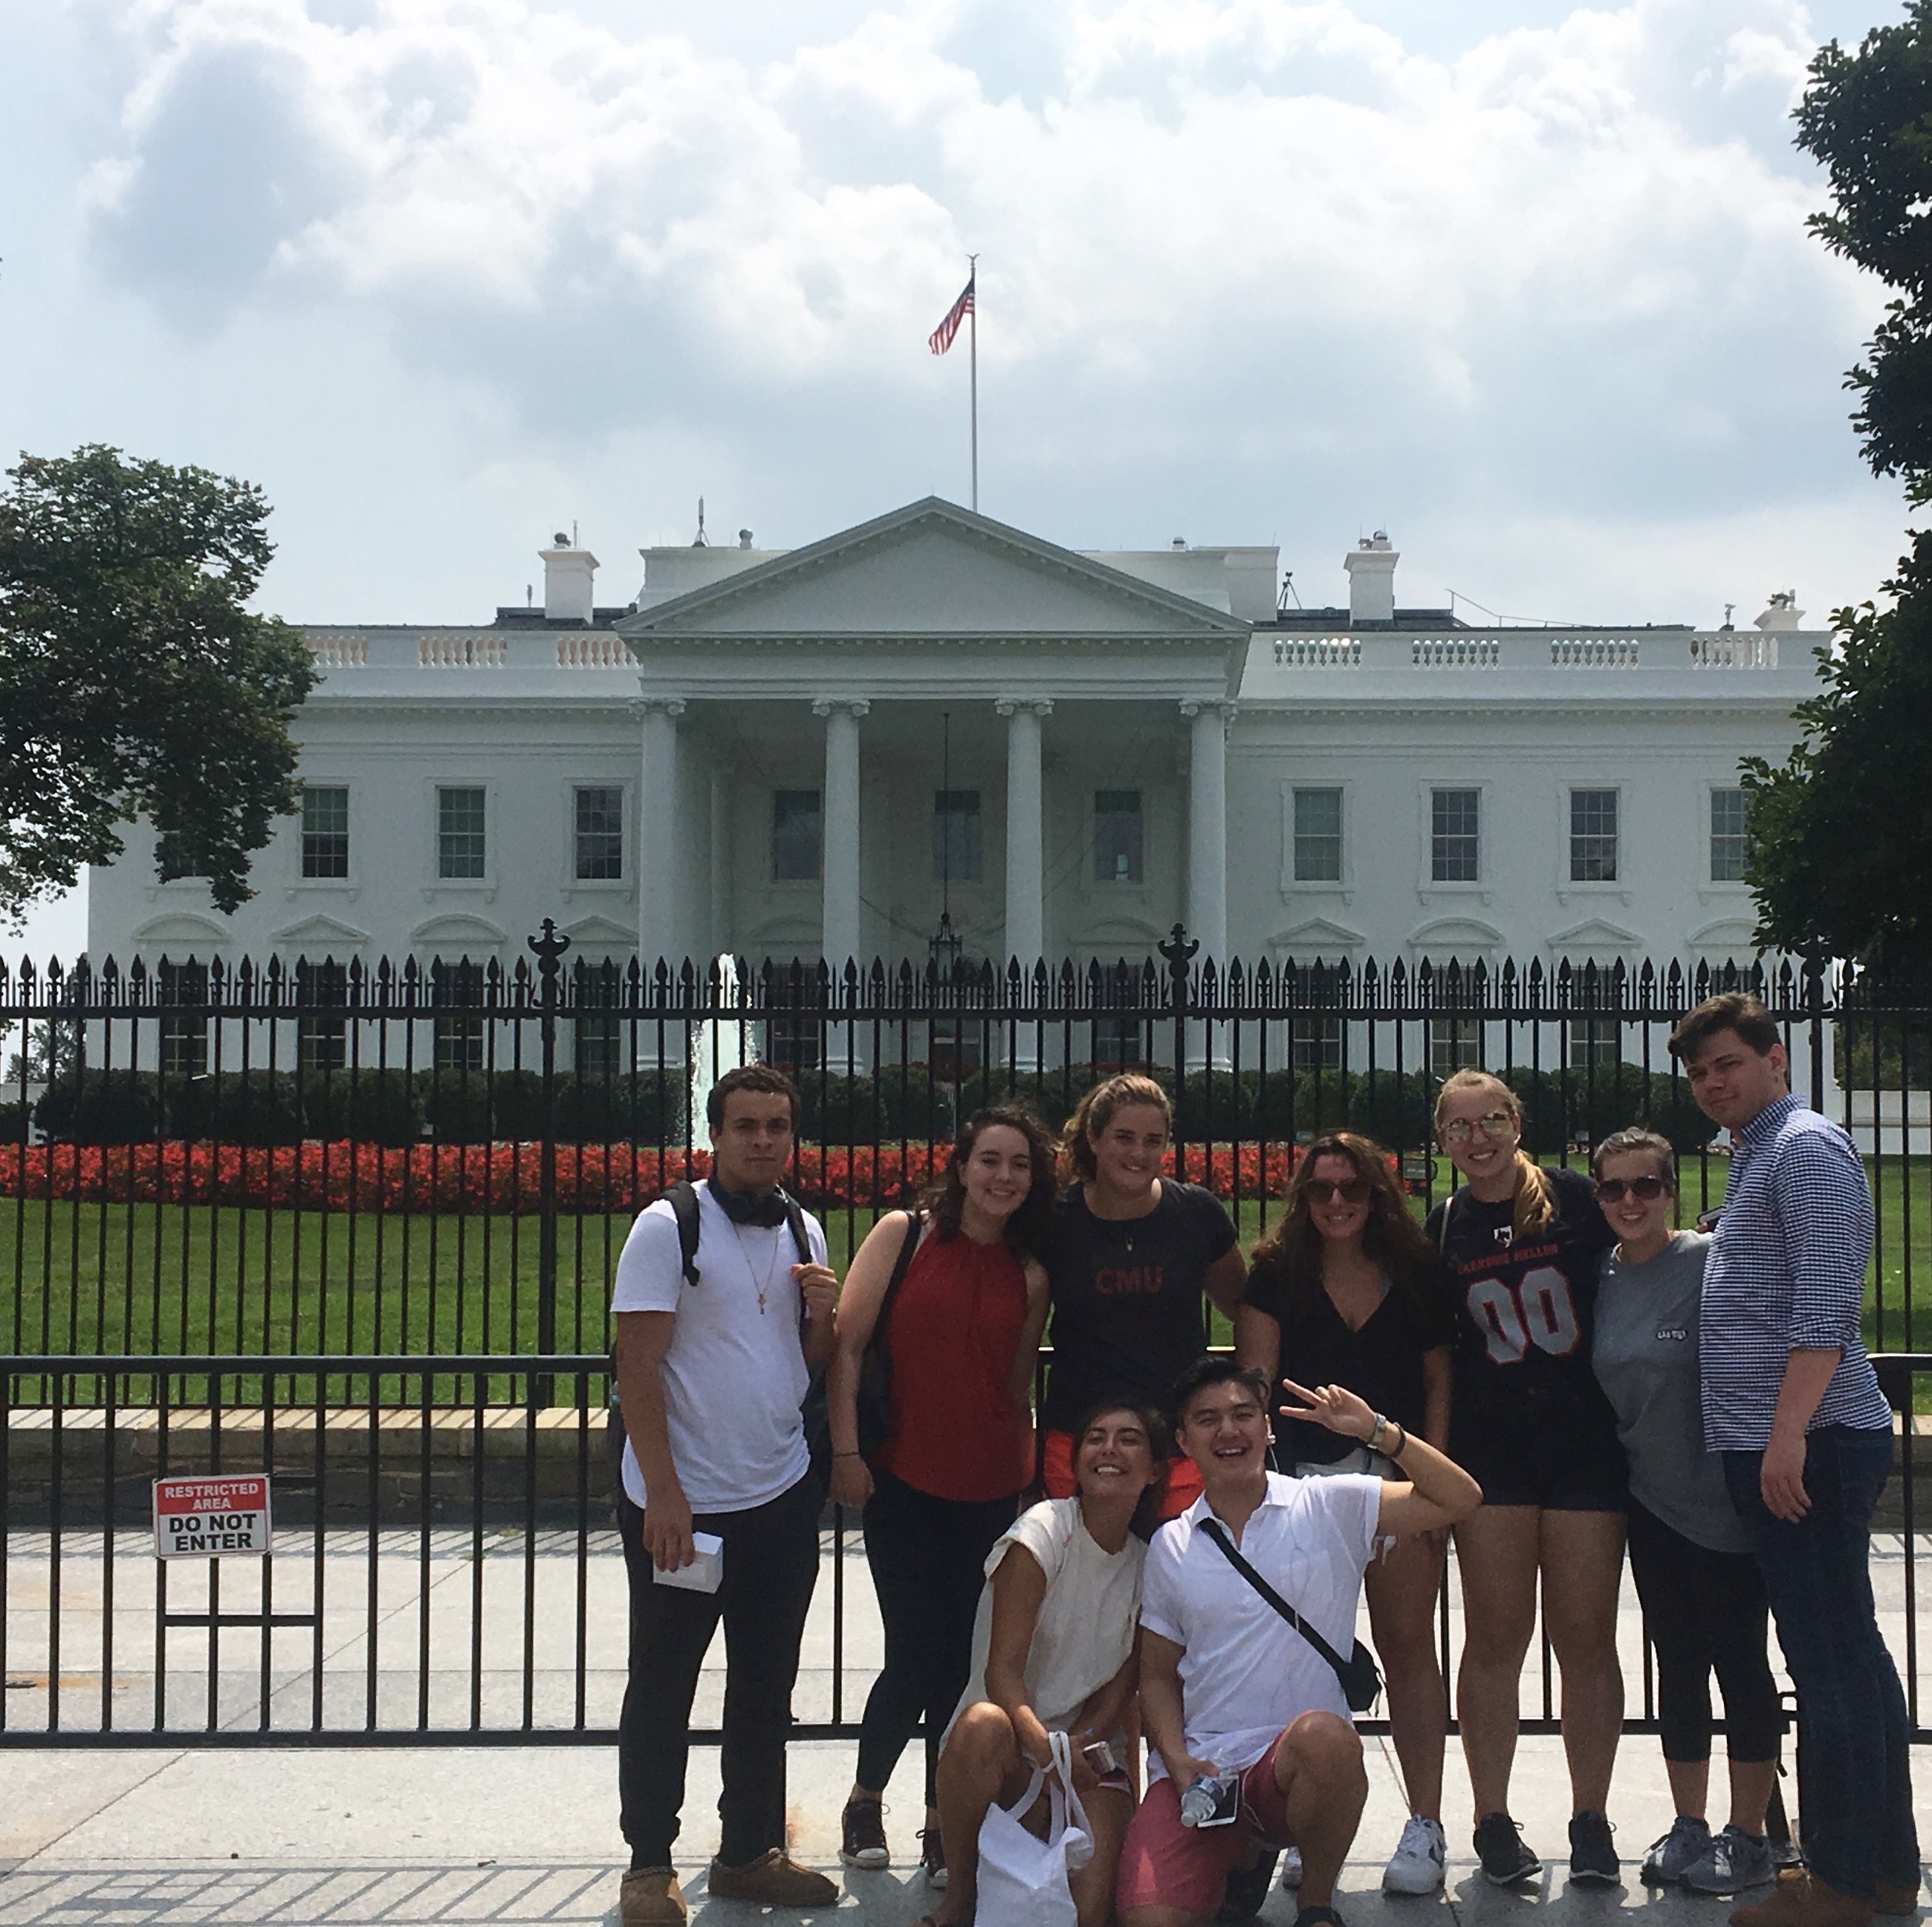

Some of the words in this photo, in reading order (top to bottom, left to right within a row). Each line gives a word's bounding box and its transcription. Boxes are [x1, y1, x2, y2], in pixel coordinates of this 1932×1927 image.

[1095, 1266, 1164, 1295] CMU
[1466, 1266, 1581, 1365] 00
[165, 1483, 258, 1498] RESTRICTED
[192, 1497, 231, 1510] AREA
[169, 1516, 201, 1533] DO
[210, 1513, 256, 1531] NOT
[175, 1532, 252, 1552] ENTER
